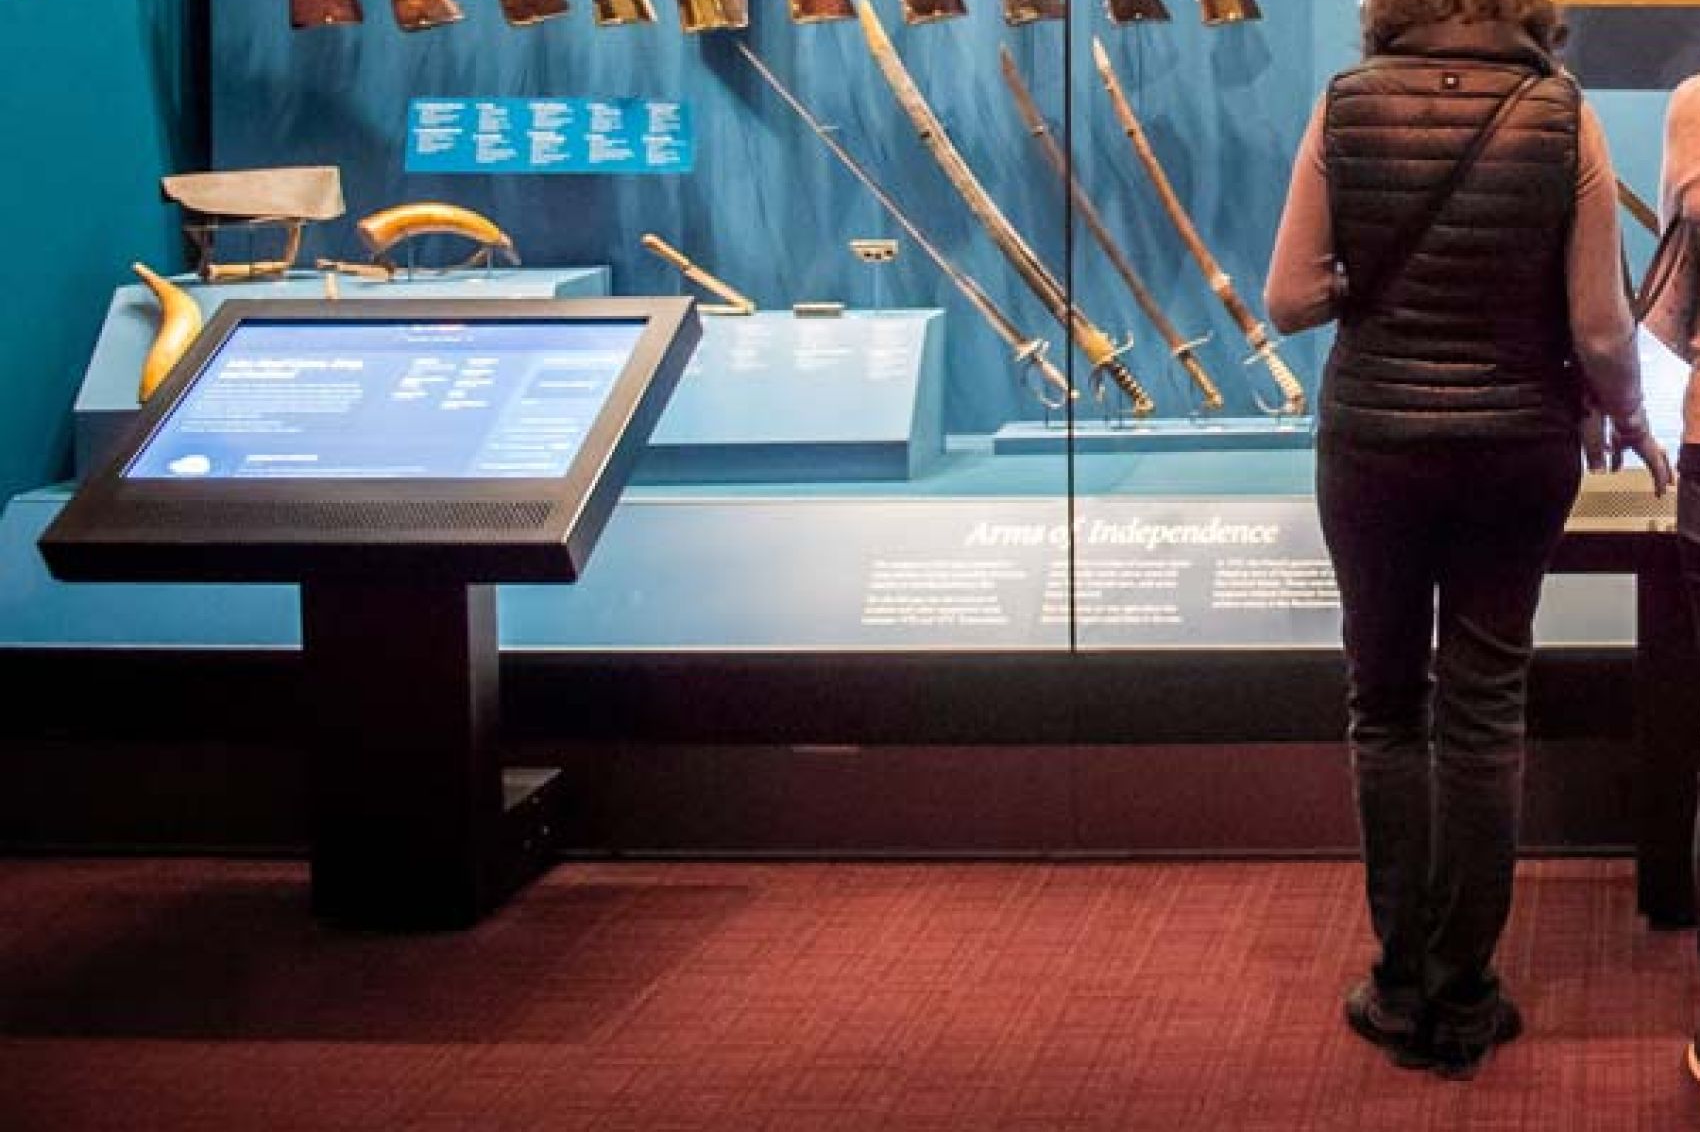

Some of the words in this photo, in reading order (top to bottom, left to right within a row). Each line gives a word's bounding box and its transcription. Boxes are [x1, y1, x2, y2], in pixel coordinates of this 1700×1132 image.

[964, 521, 1046, 547] Arms
[1048, 517, 1086, 550] of
[1088, 516, 1280, 550] Independence
